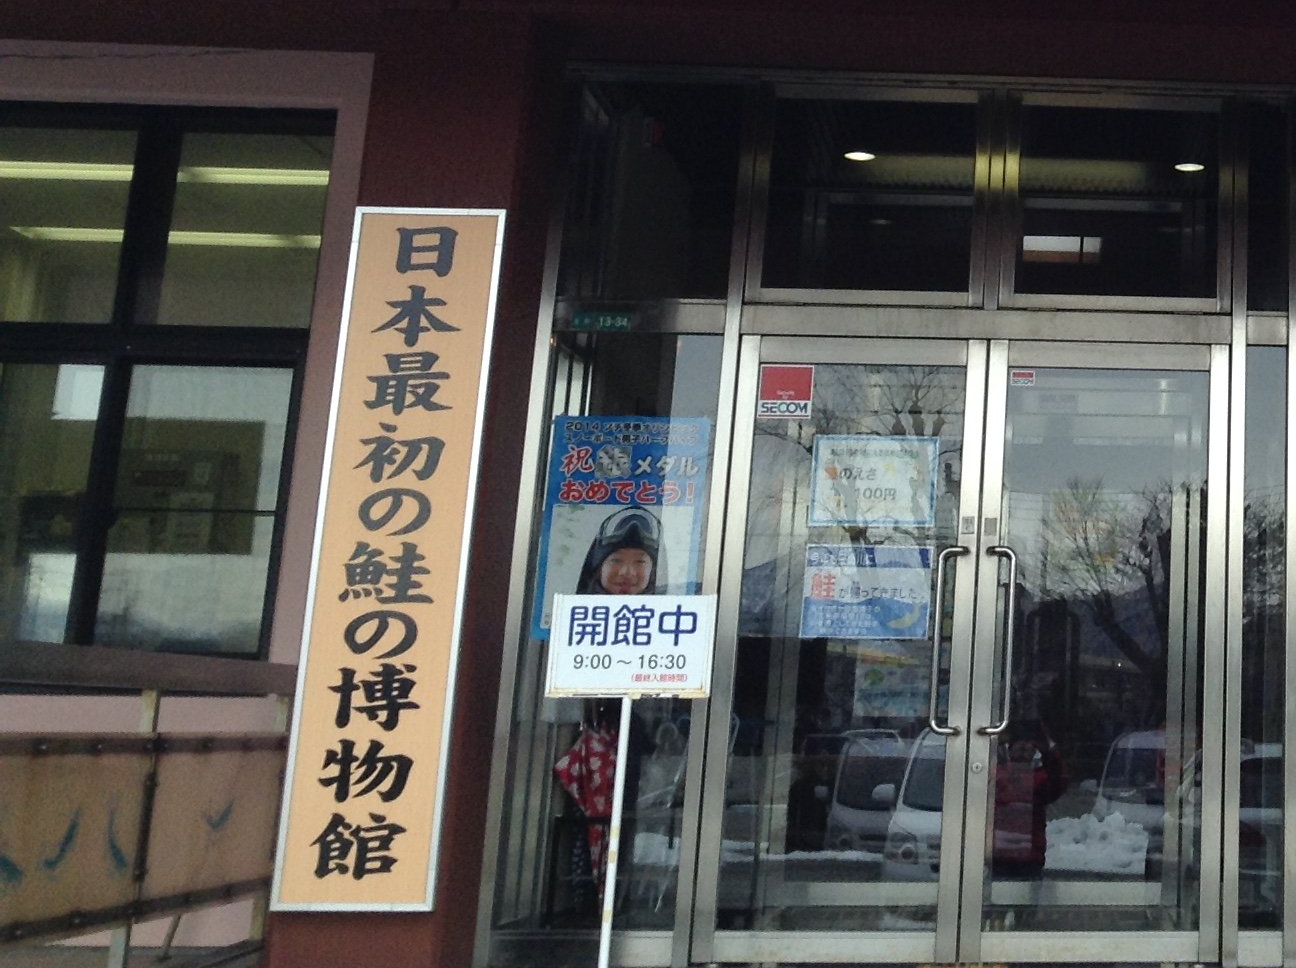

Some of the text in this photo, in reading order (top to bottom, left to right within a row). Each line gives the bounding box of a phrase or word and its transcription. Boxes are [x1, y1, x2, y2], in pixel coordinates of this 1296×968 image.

[760, 401, 808, 414] SECOM
[565, 421, 601, 432] 2014
[310, 225, 461, 882] 日本最初の鮭の博物館
[567, 603, 698, 647] 開館中
